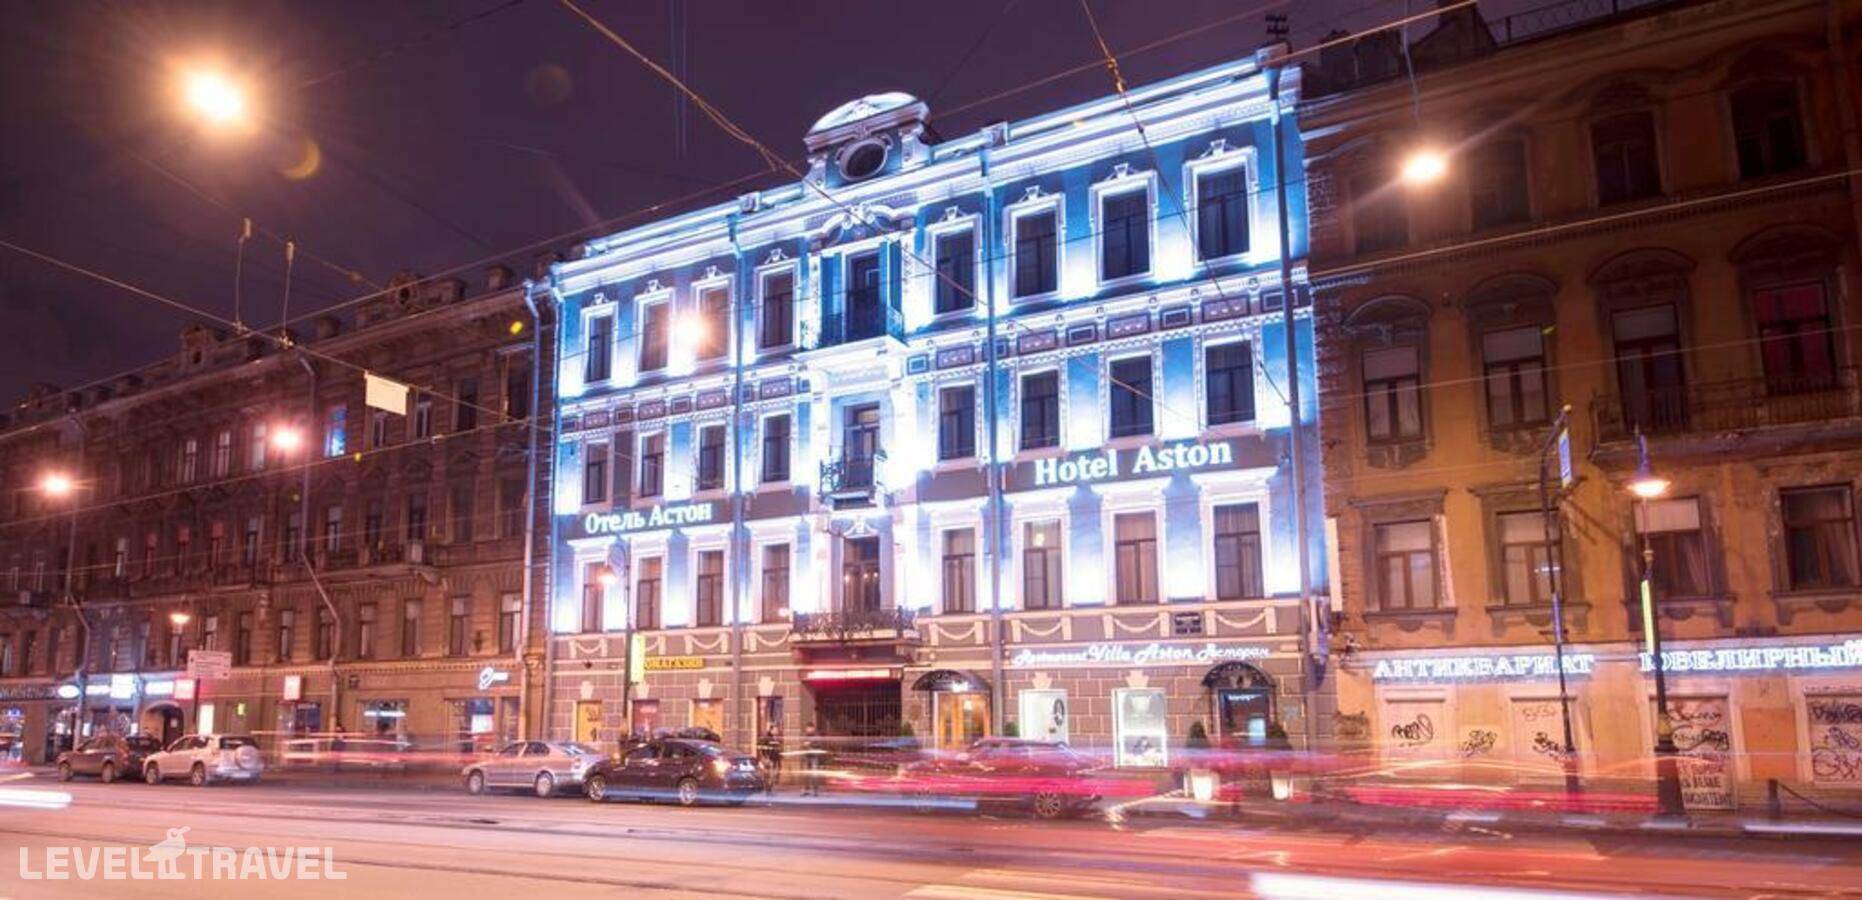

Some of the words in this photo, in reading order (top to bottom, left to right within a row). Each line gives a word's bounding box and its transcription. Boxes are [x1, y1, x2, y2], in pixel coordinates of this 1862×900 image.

[1034, 449, 1119, 486] Hotel
[1132, 442, 1232, 474] Aston
[585, 512, 645, 534] Отель
[649, 503, 712, 527] Астон
[1088, 644, 1131, 662] Villa
[1132, 643, 1193, 665] Aston
[1373, 654, 1595, 677] АНТИКВАРИАТ
[1639, 640, 1862, 671] ЮВЕЛИРНЫЙ
